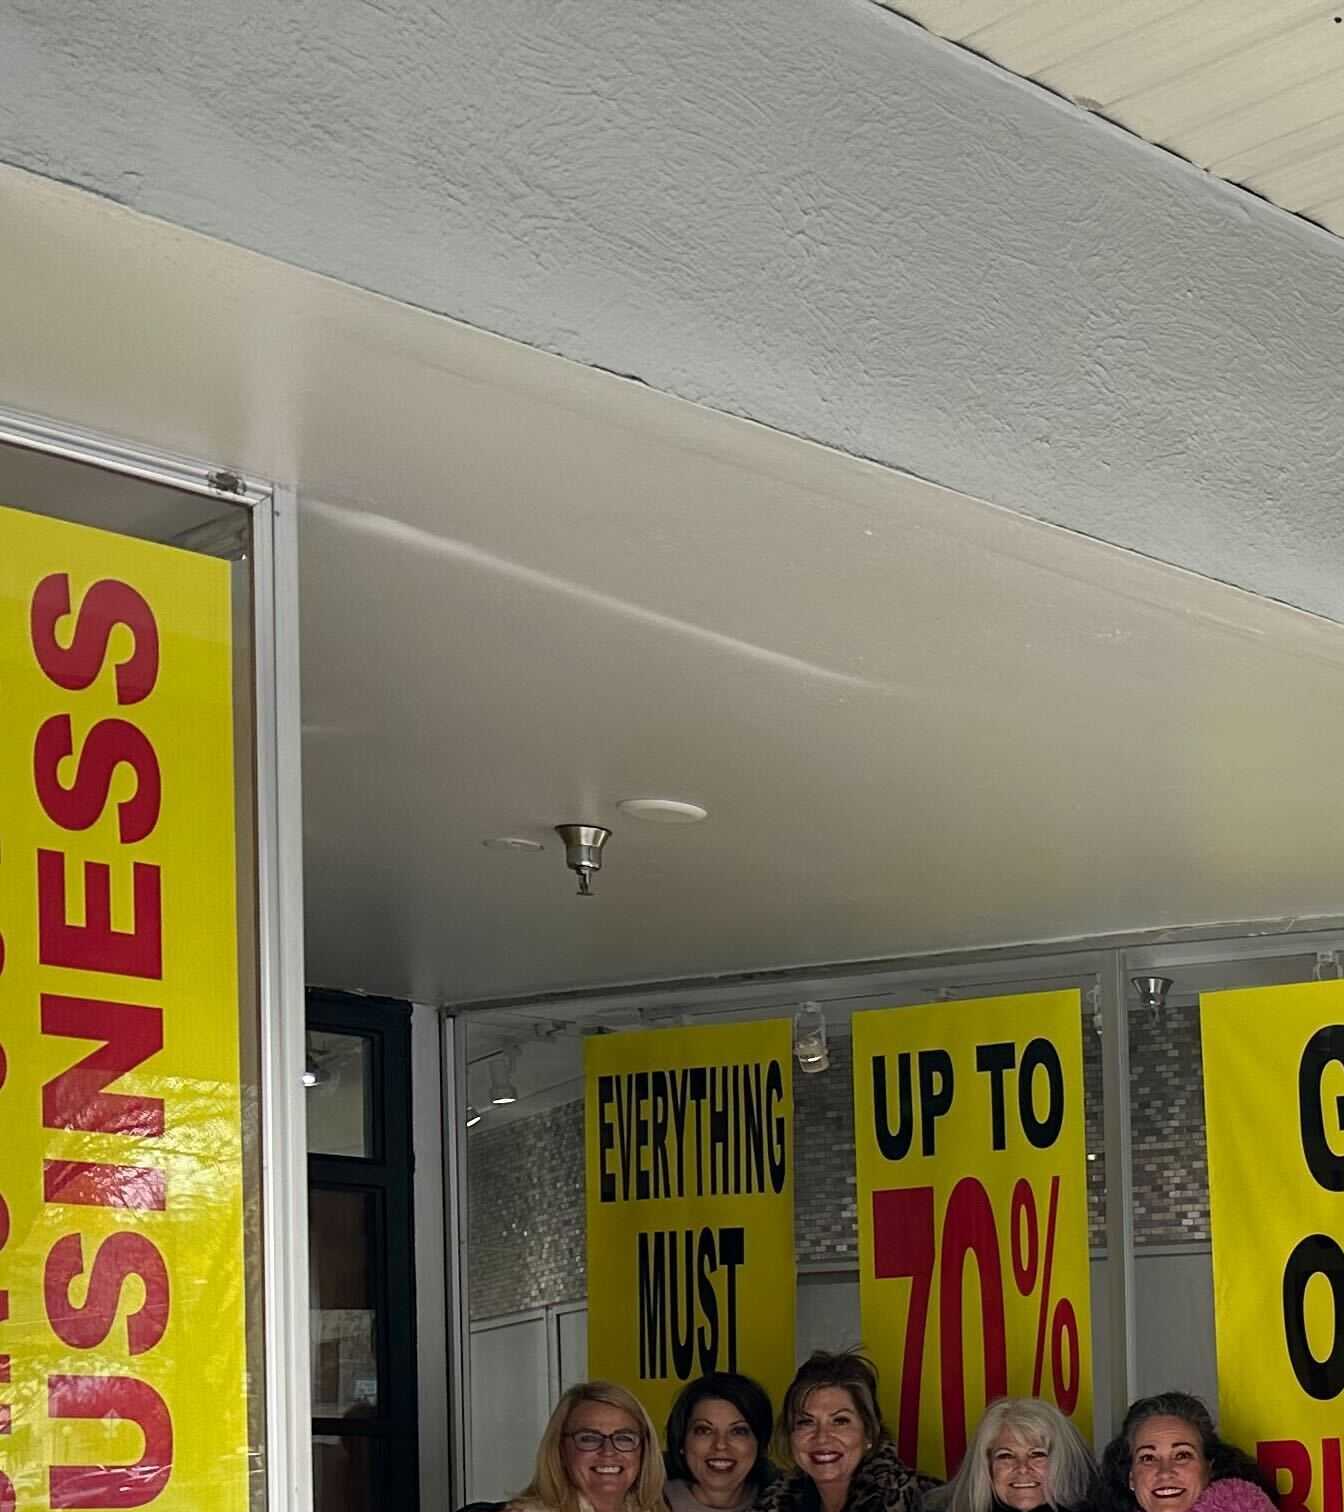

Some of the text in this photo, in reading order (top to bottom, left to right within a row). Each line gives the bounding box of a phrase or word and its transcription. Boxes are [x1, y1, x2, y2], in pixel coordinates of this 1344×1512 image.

[598, 1059, 786, 1203] EVERYTHING
[871, 1036, 1066, 1161] UP TO
[637, 1226, 745, 1381] MUST
[871, 1175, 1081, 1482] 70%
